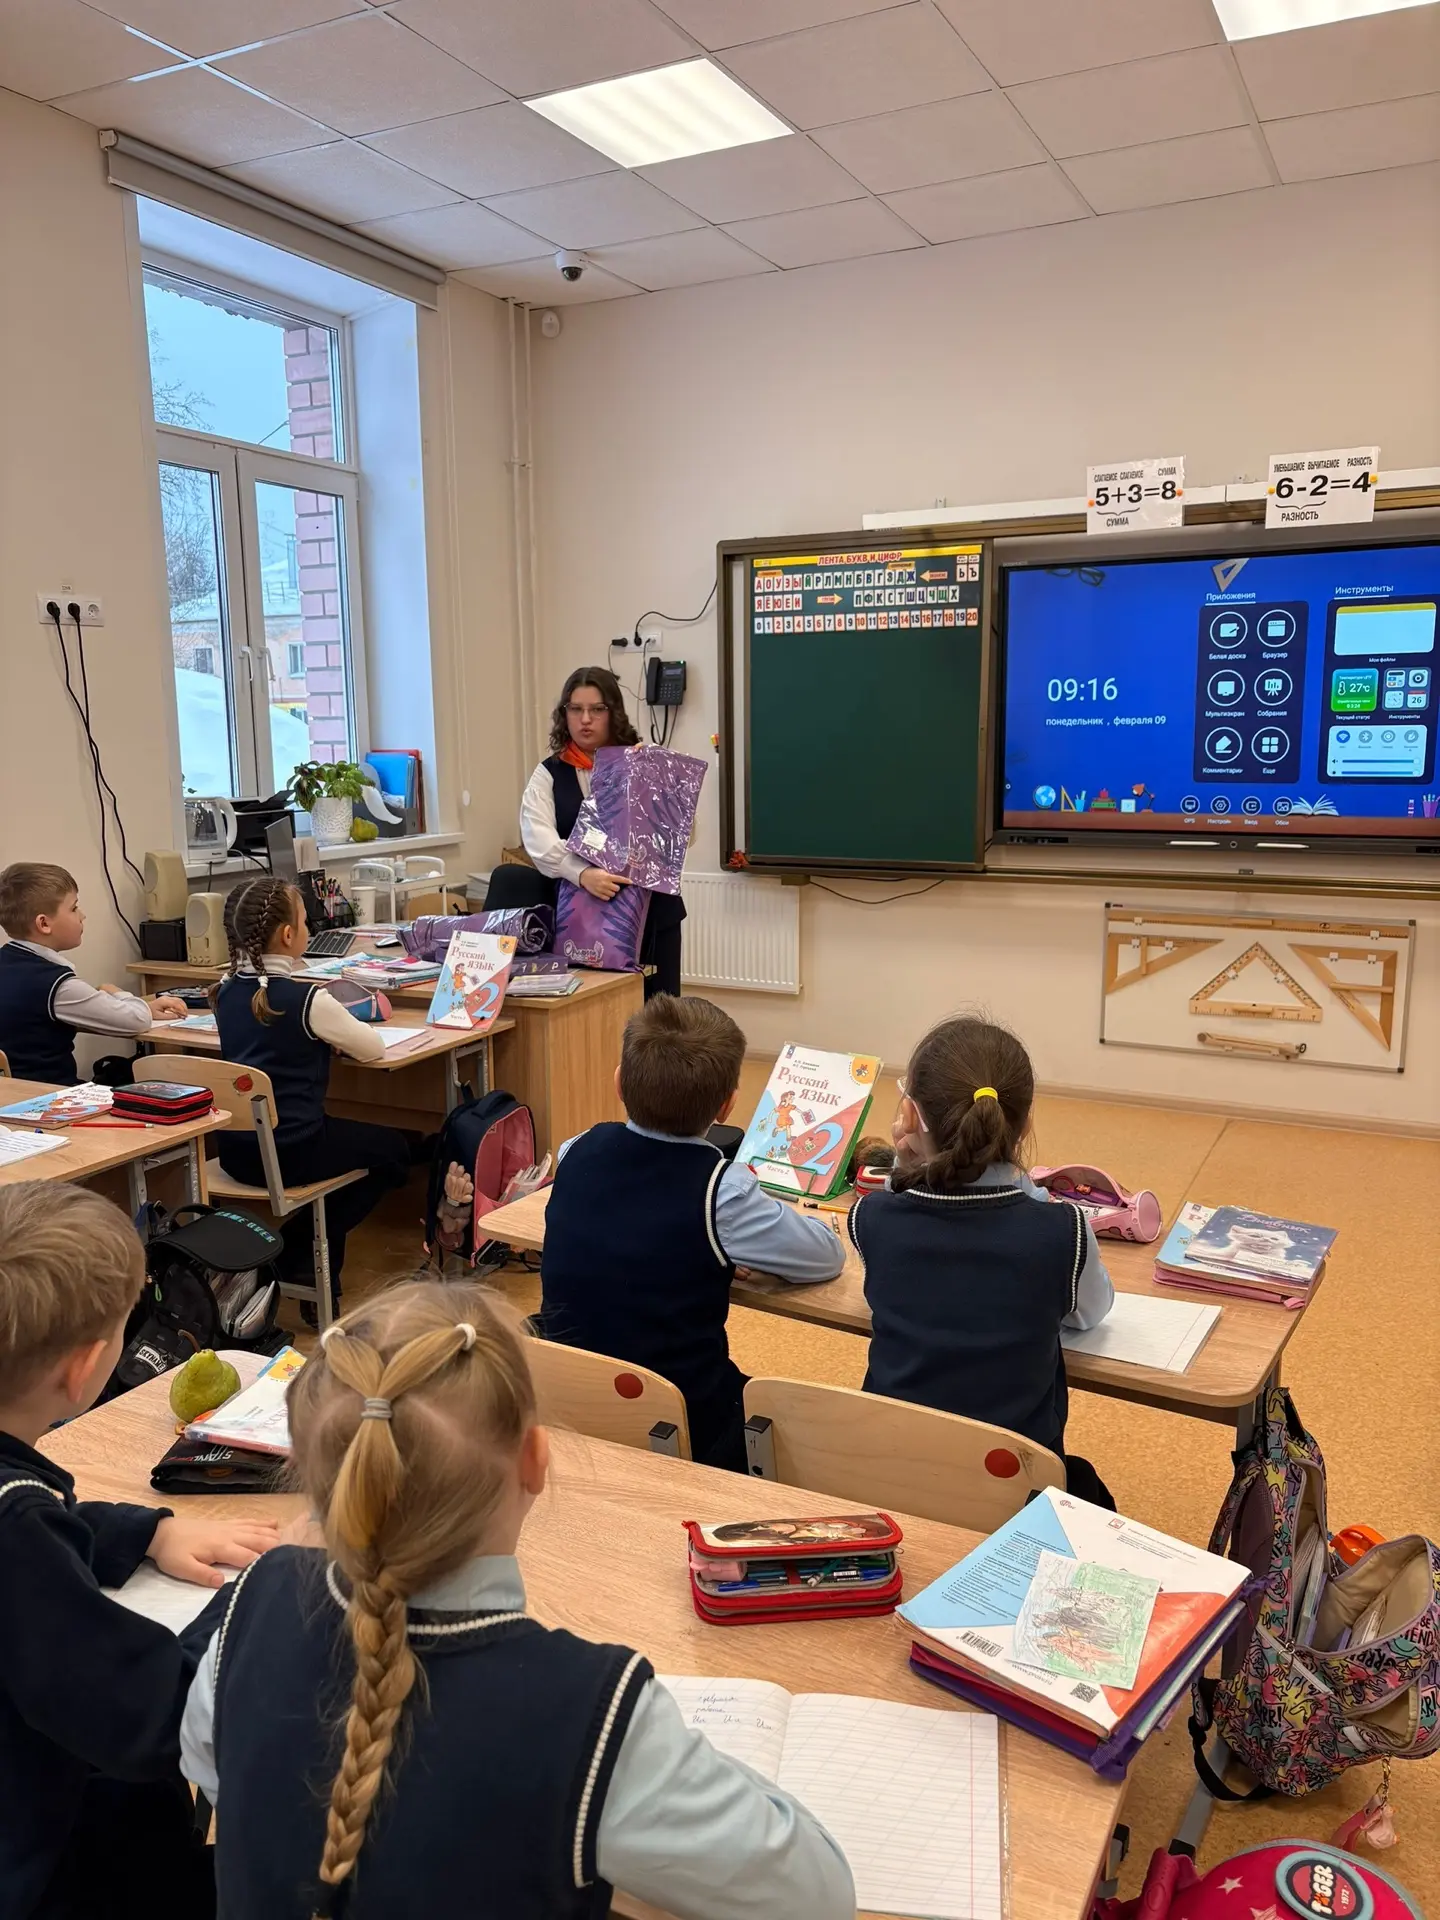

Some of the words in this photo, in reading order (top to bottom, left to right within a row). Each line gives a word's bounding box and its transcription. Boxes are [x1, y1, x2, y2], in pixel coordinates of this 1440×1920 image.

[1273, 462, 1305, 472] УМЕНЬШАЕМОЕ
[1307, 459, 1340, 470] ВЫЧИТАЕМОЕ
[1346, 456, 1372, 467] РАЗНОСТЬ
[1158, 466, 1176, 476] СУММА
[1106, 517, 1129, 527] СУММА
[1281, 511, 1318, 522] РАЗНОСТЬ
[818, 556, 844, 564] ЛЕНТА
[846, 554, 868, 563] БУКВ
[870, 553, 876, 561] И
[878, 552, 902, 562] ЦИФР
[1335, 586, 1394, 595] Инструменты
[1206, 592, 1256, 602] Приложения
[1048, 677, 1118, 702] 09:16
[1046, 717, 1104, 726] понедельник
[1113, 716, 1152, 726] февраля
[1155, 716, 1166, 724] 09
[450, 946, 486, 960] Русский
[472, 981, 499, 1018] 2
[778, 1066, 829, 1090] Русский
[802, 1122, 844, 1176] 2
[767, 1164, 784, 1174] Часть
[247, 1222, 276, 1242] OVER
